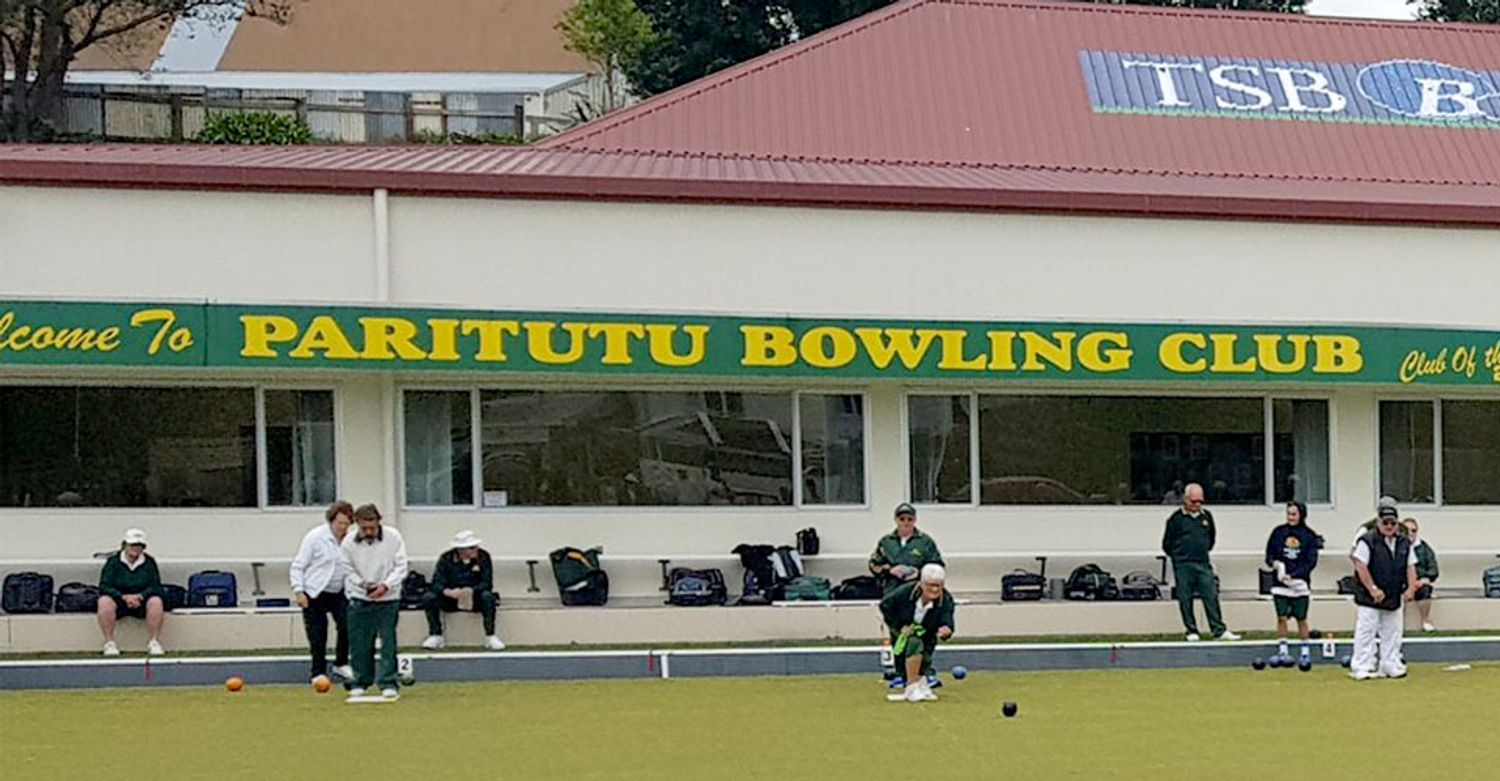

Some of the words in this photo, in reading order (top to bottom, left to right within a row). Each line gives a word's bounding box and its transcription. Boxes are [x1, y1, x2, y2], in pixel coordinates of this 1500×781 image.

[1123, 60, 1347, 113] TSB
[131, 309, 194, 355] To
[240, 314, 709, 366] PARITUTU
[740, 325, 1133, 372] BOWLING
[1158, 332, 1363, 375] CLUB
[1400, 349, 1447, 383] Club
[1451, 346, 1476, 378] Of
